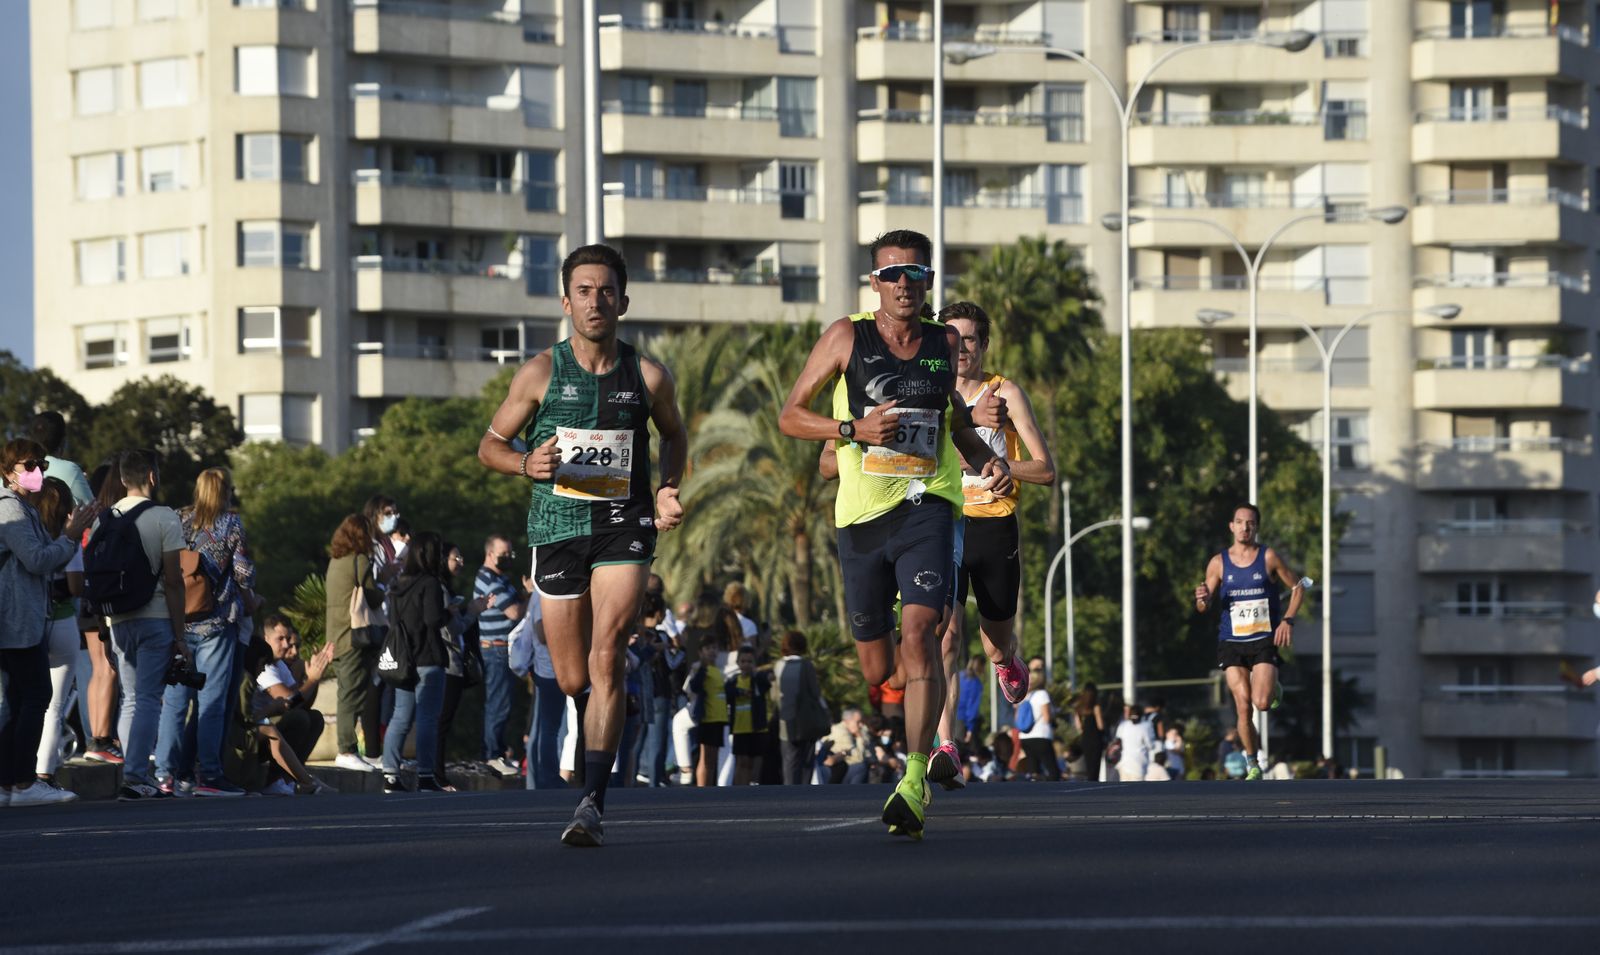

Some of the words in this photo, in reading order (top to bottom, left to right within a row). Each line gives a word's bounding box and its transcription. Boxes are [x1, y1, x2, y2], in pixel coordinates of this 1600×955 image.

[897, 386, 943, 396] MENORCA
[563, 430, 577, 441] edp
[589, 432, 603, 442] edp
[615, 431, 628, 442] edp
[570, 446, 613, 467] 228
[1239, 607, 1259, 618] 478
